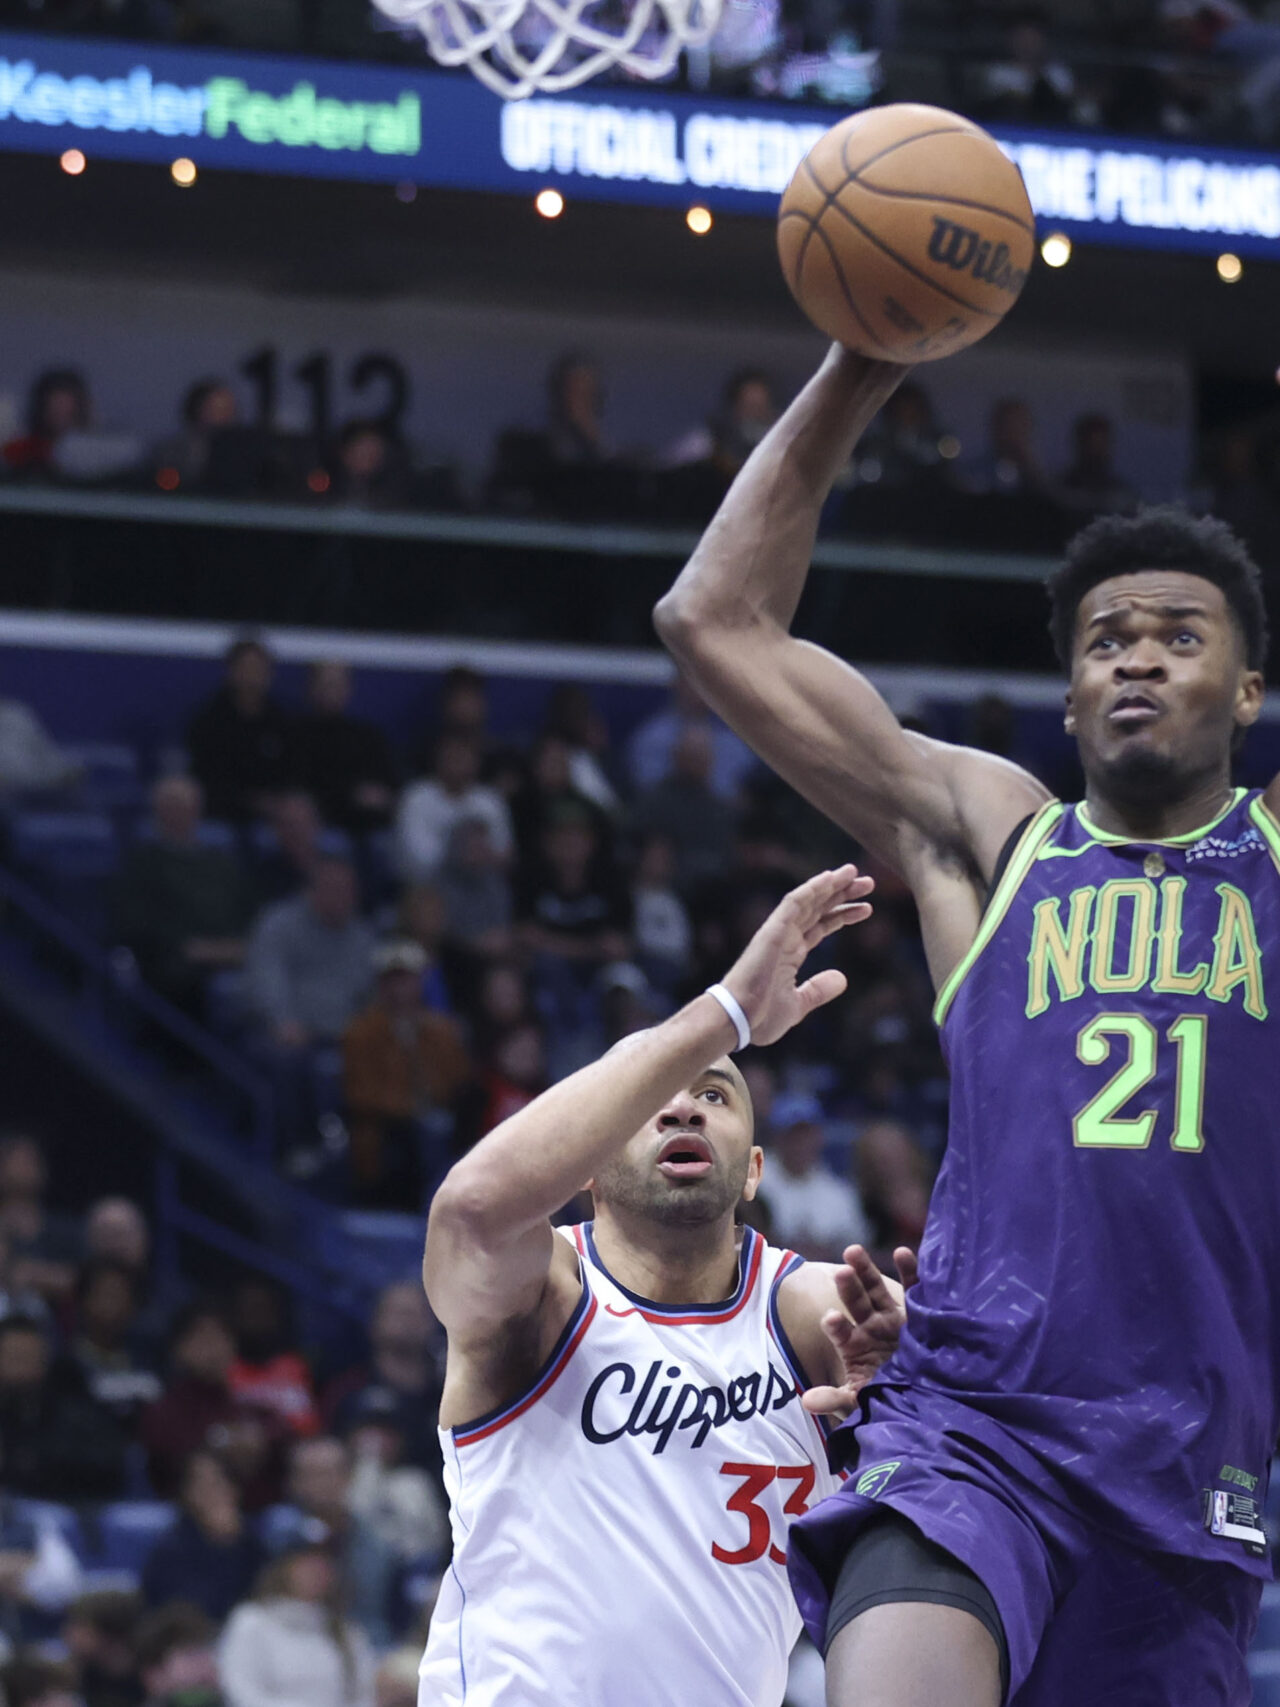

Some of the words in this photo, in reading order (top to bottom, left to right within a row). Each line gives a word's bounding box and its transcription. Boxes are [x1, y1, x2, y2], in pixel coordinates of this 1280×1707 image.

[501, 98, 689, 185] OFFICIAL
[683, 113, 831, 194] CREDI
[1025, 876, 1268, 1020] NOLA
[1073, 1012, 1208, 1153] 21
[581, 1360, 798, 1455] Clippers
[711, 1461, 815, 1565] 33
